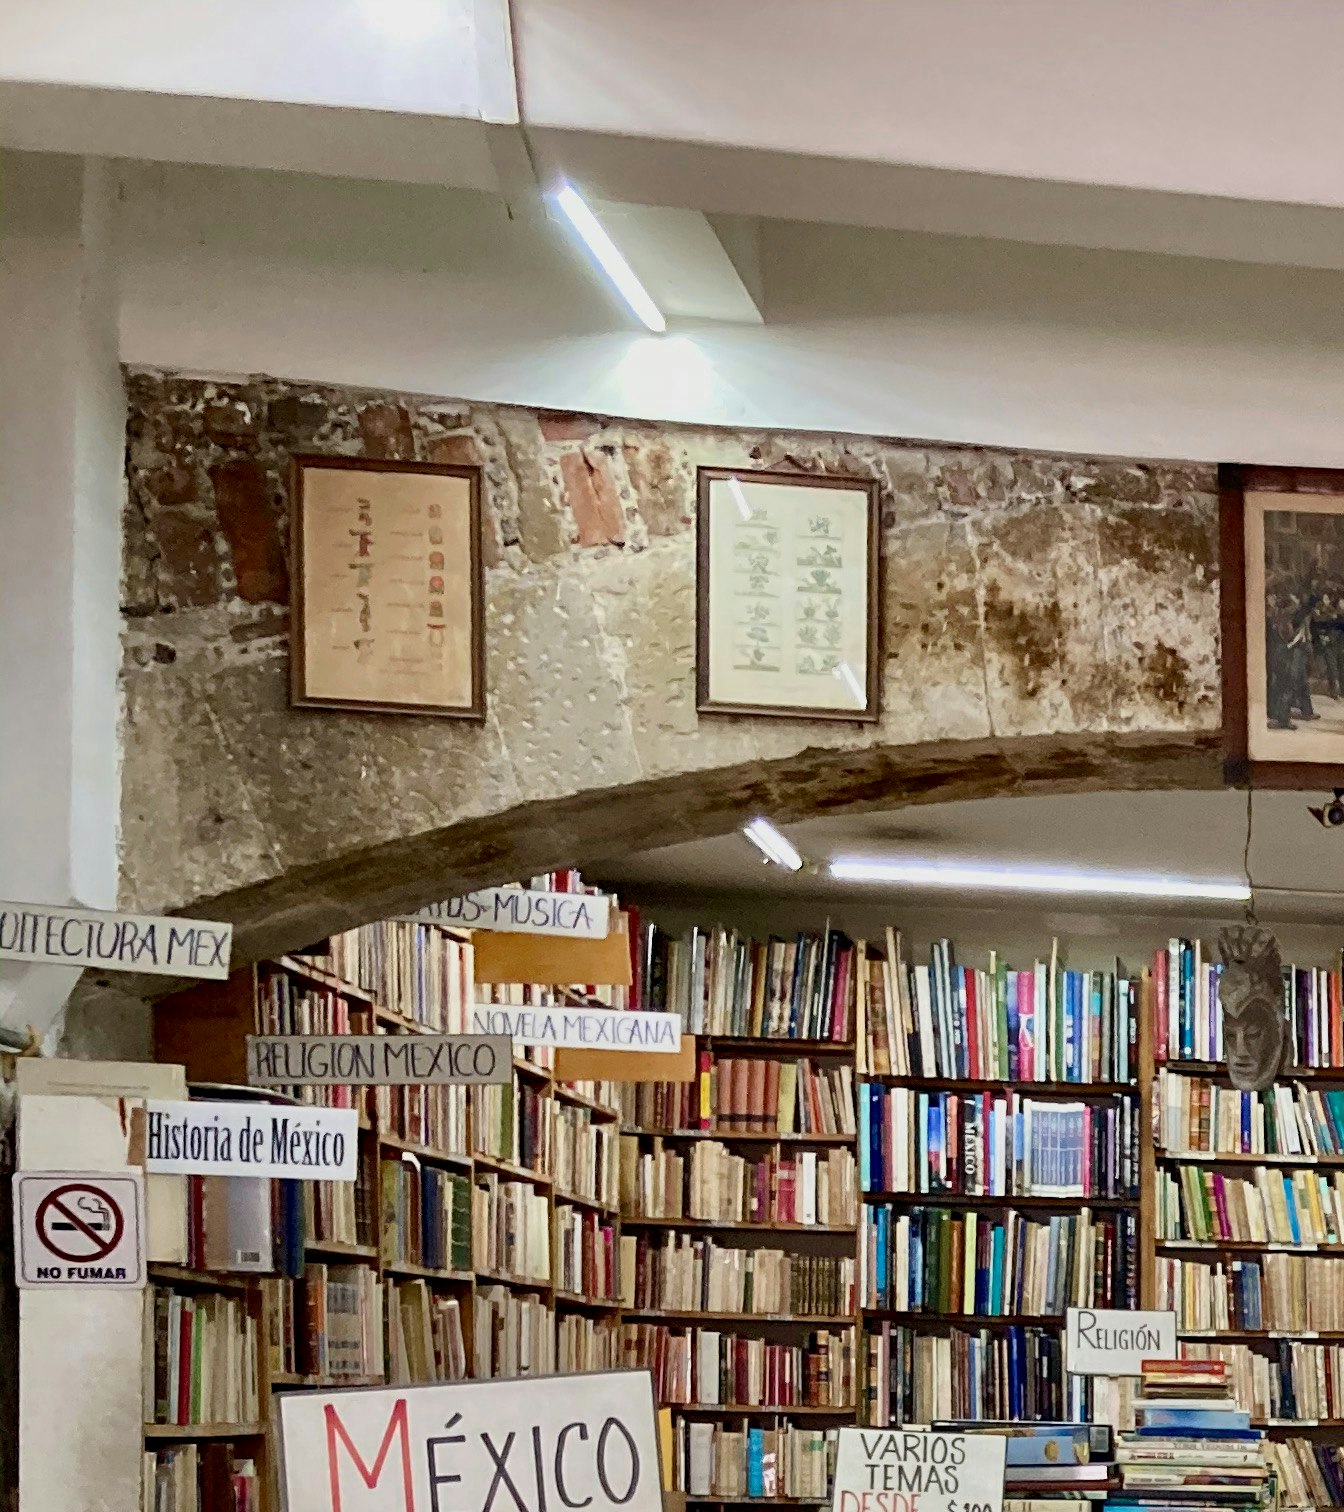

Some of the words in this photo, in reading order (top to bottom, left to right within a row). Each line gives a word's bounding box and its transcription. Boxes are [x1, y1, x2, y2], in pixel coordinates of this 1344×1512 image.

[166, 927, 228, 967] MEX
[473, 1012, 557, 1041] NOVELA
[563, 1015, 676, 1046] MEXICANA
[256, 1042, 374, 1079] RELIGION
[384, 1042, 496, 1078] MEXICO
[148, 1111, 232, 1162] Historia
[239, 1116, 264, 1158] de
[270, 1117, 345, 1166] México
[37, 1267, 61, 1280] NO
[68, 1267, 126, 1280] FUMAR
[860, 1432, 967, 1465] VARIOS
[865, 1463, 960, 1494] TEMAS
